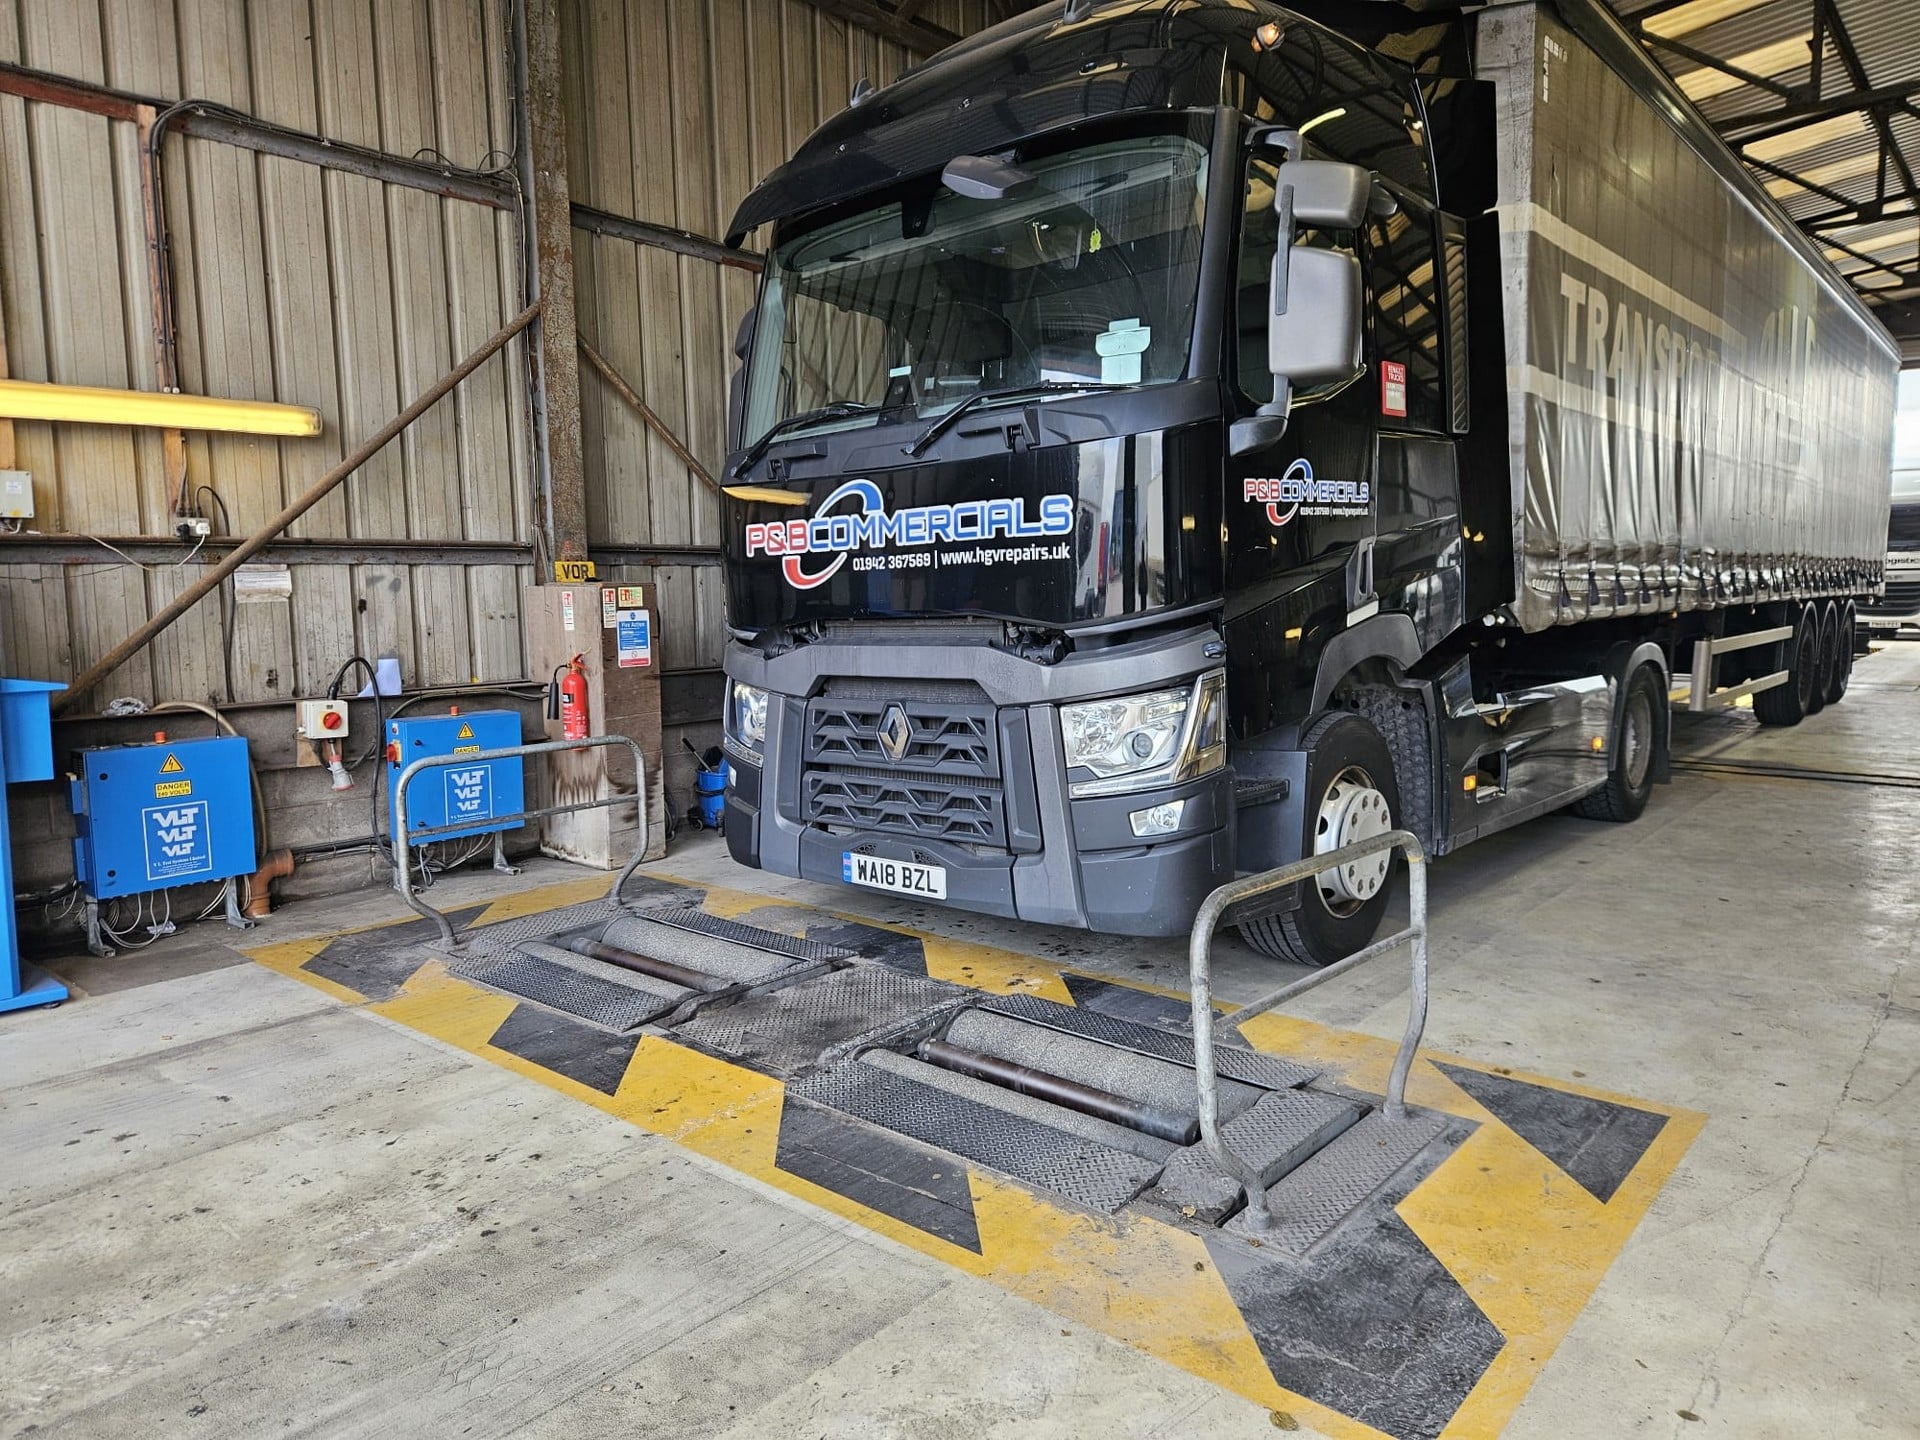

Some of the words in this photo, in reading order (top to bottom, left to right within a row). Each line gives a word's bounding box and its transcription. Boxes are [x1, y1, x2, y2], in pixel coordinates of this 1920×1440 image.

[853, 556, 886, 571] 01942
[888, 553, 931, 570] 367569
[940, 542, 1071, 566] www.hgvrepairs.uk
[562, 564, 589, 580] VOR
[455, 746, 479, 754] DANGER
[157, 781, 190, 791] DANGER
[170, 788, 190, 796] VOLTS
[857, 859, 896, 886] WA18
[901, 866, 938, 894] BZL
